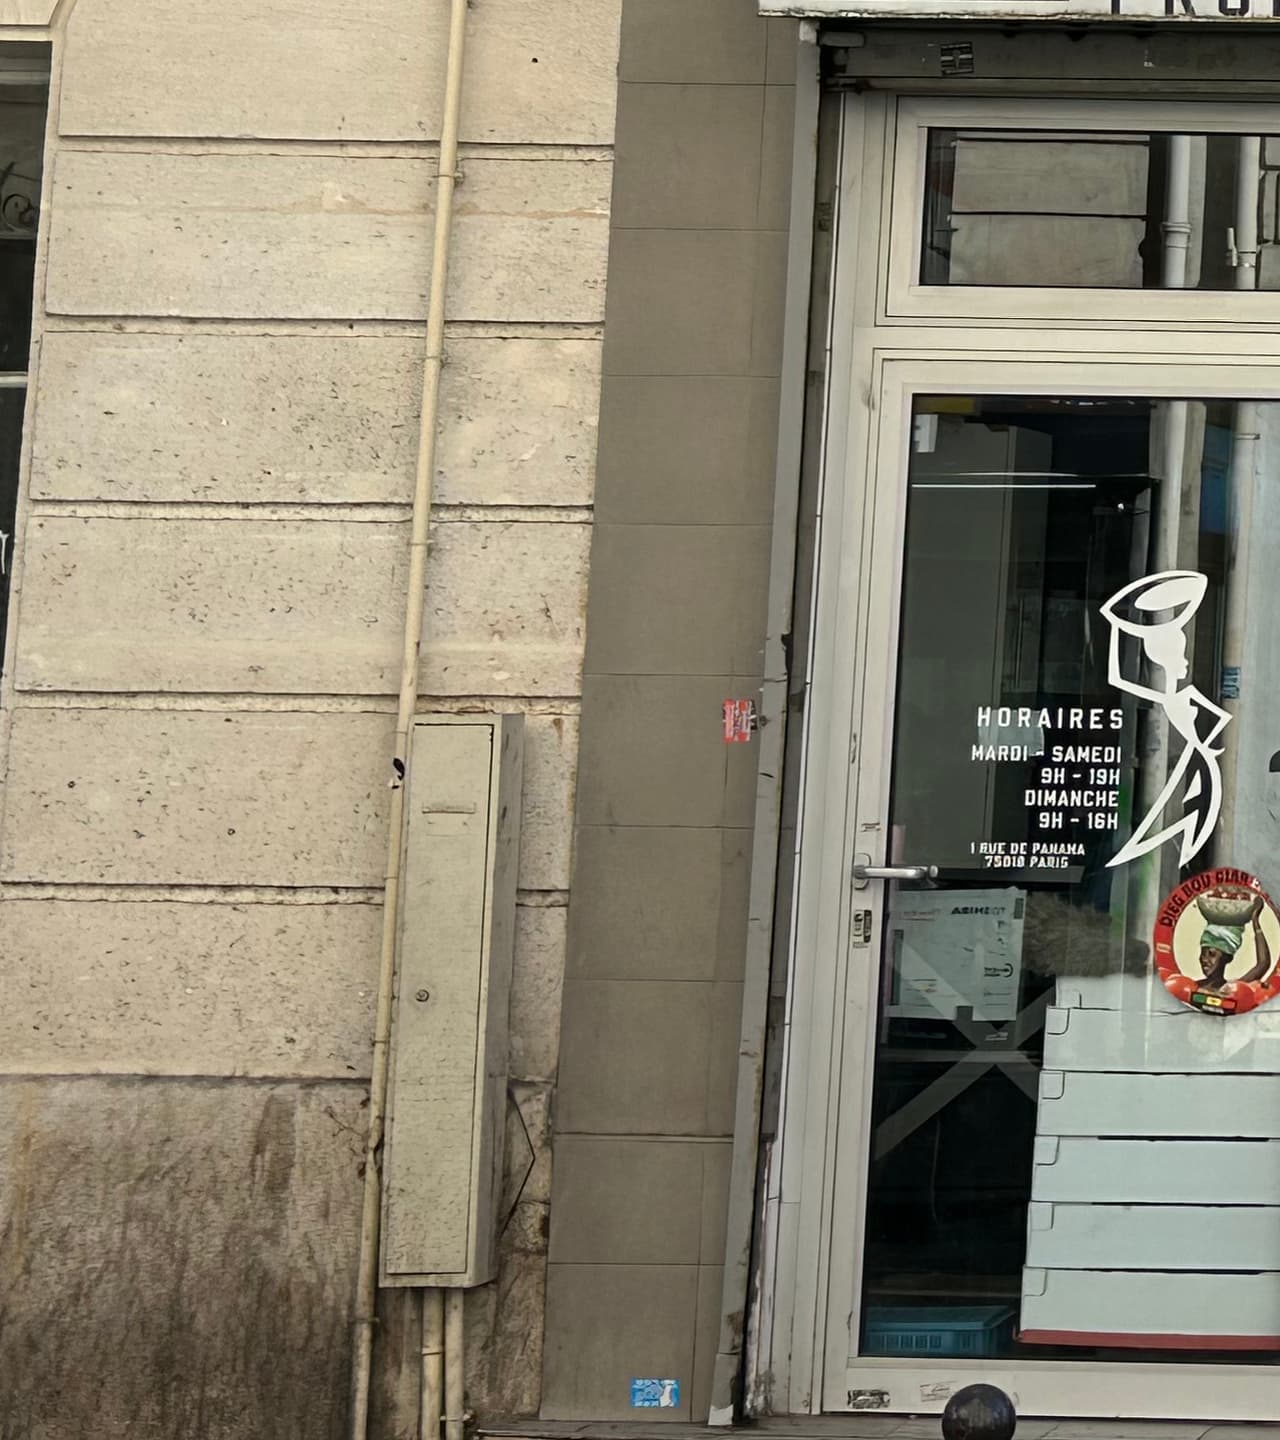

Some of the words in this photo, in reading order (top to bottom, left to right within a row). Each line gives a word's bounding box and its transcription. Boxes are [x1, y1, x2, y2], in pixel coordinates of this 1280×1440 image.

[977, 707, 1124, 730] HORAIRES
[971, 745, 1027, 762] MARDI
[1051, 746, 1121, 763] SAMEDI
[1041, 767, 1065, 784] 9H
[1090, 768, 1120, 785] 19H
[1025, 790, 1119, 807] DIMANCHE
[1039, 812, 1063, 829] 9H
[1088, 812, 1119, 830] 16H
[970, 842, 976, 855] 1
[980, 842, 1007, 855] RUE
[1010, 842, 1028, 855] DE
[1032, 842, 1086, 856] PANAMA
[1029, 856, 1069, 869] PARIS
